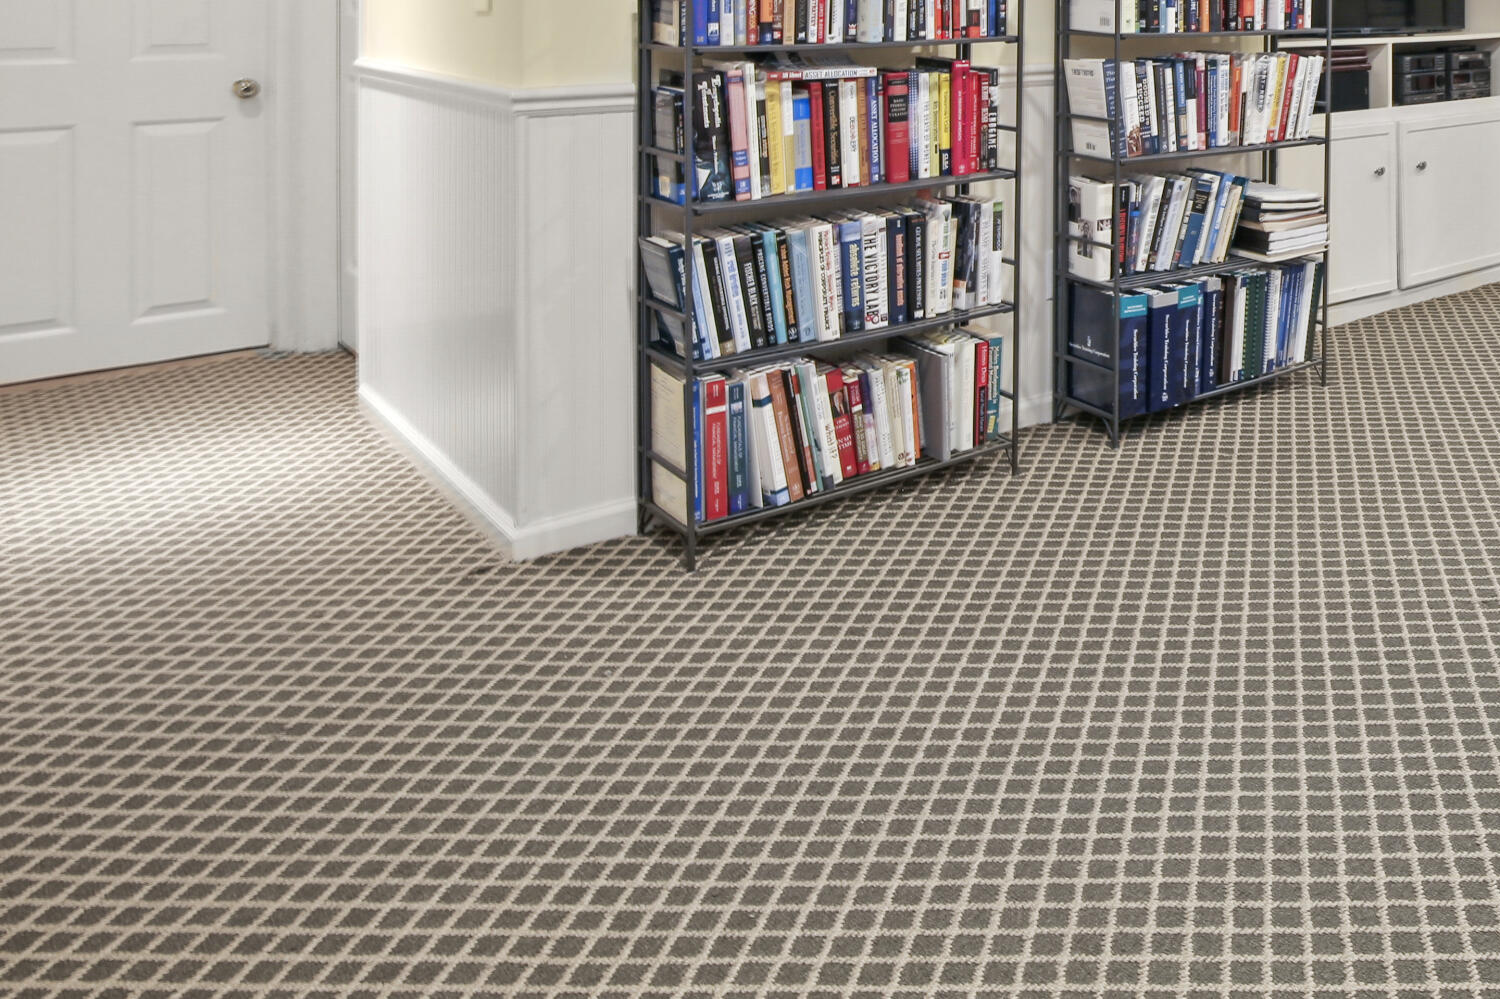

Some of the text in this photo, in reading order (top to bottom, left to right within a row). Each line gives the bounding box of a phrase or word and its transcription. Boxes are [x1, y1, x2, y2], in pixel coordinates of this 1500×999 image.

[804, 70, 824, 79] ASSET
[824, 69, 858, 78] ALLOCATION
[870, 100, 878, 119] ASSET
[1142, 79, 1150, 116] DOOMED
[988, 112, 996, 149] ENDGAME
[744, 262, 758, 306] FISCHER BLACK
[820, 273, 828, 305] CORPORATE
[850, 244, 860, 306] absolute returns
[864, 232, 880, 316] THE VICTORY LAB
